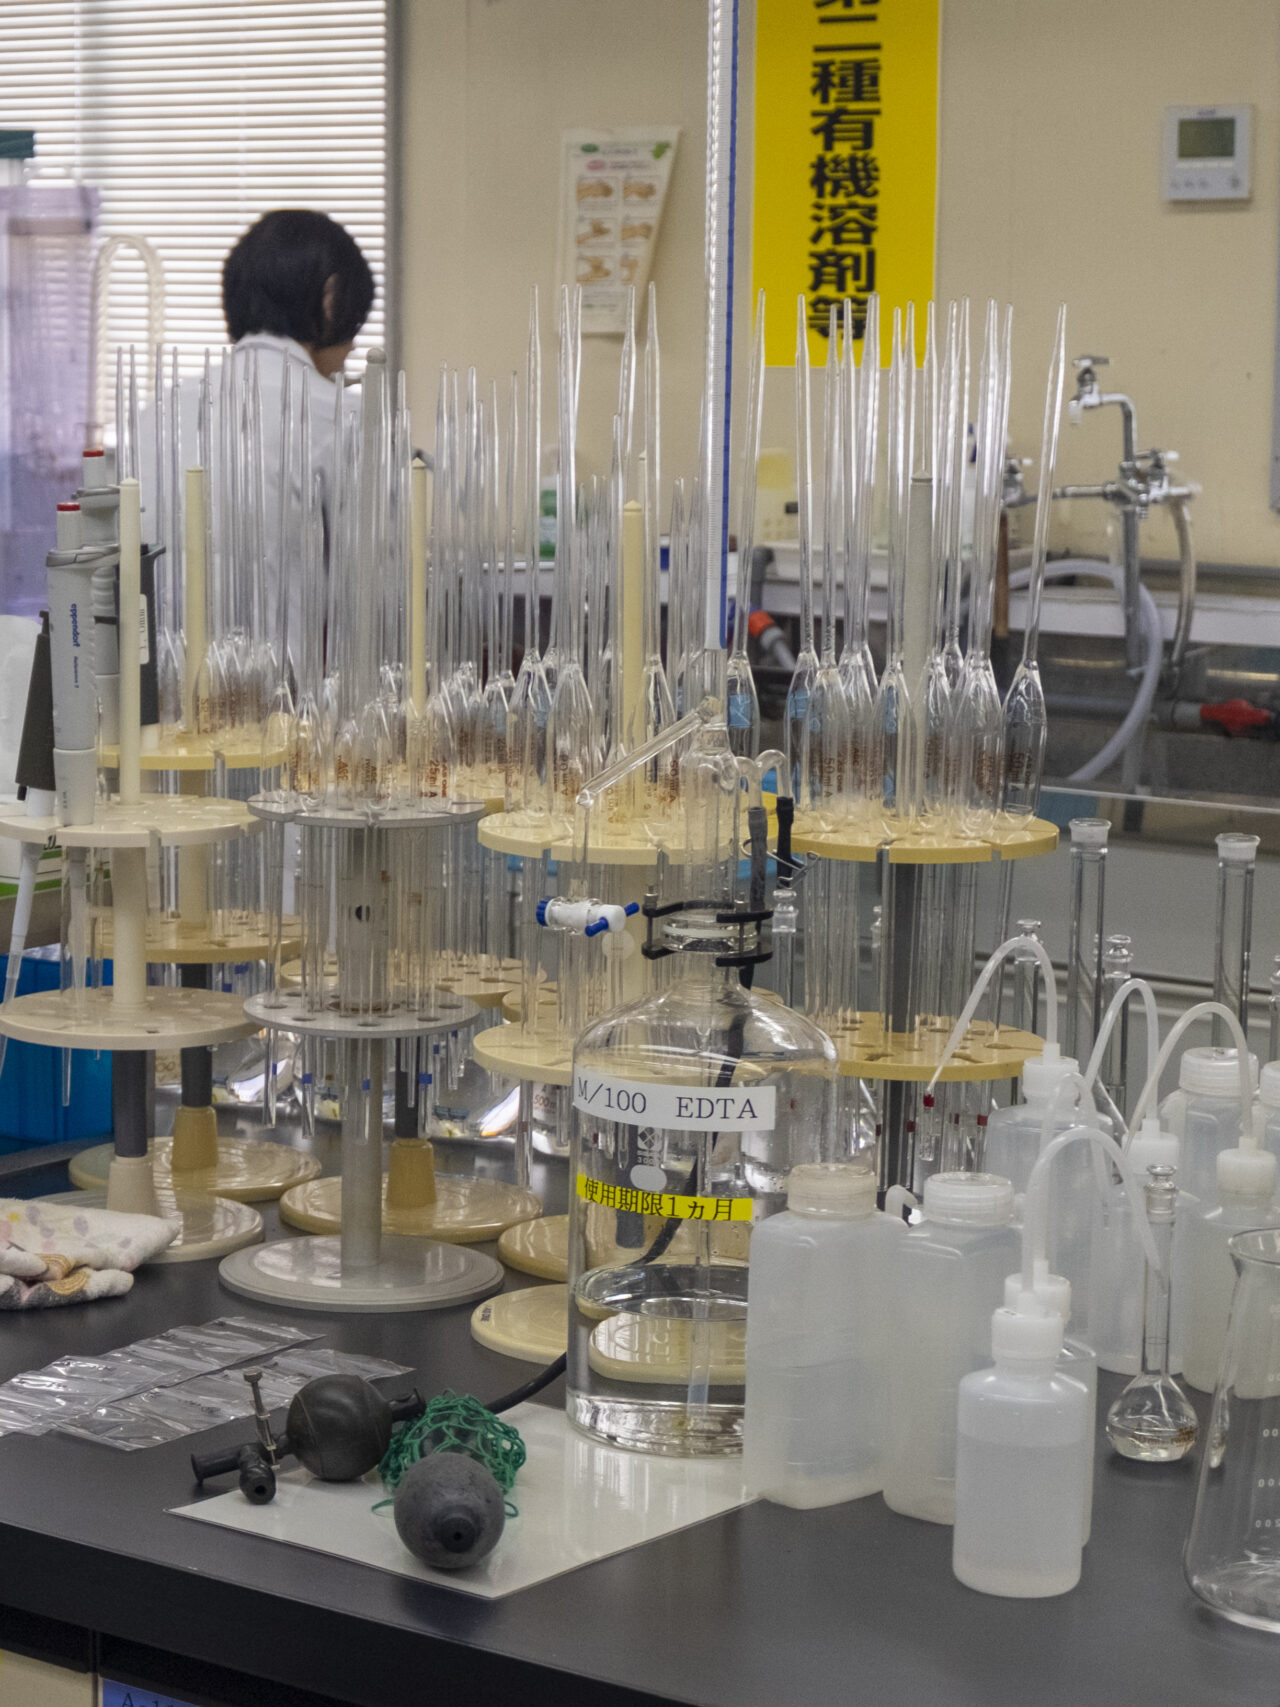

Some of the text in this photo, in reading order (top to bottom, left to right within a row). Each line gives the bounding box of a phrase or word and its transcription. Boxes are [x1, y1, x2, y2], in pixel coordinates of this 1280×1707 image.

[70, 603, 80, 647] eppendorf
[577, 1076, 758, 1119] M/100 EDTA
